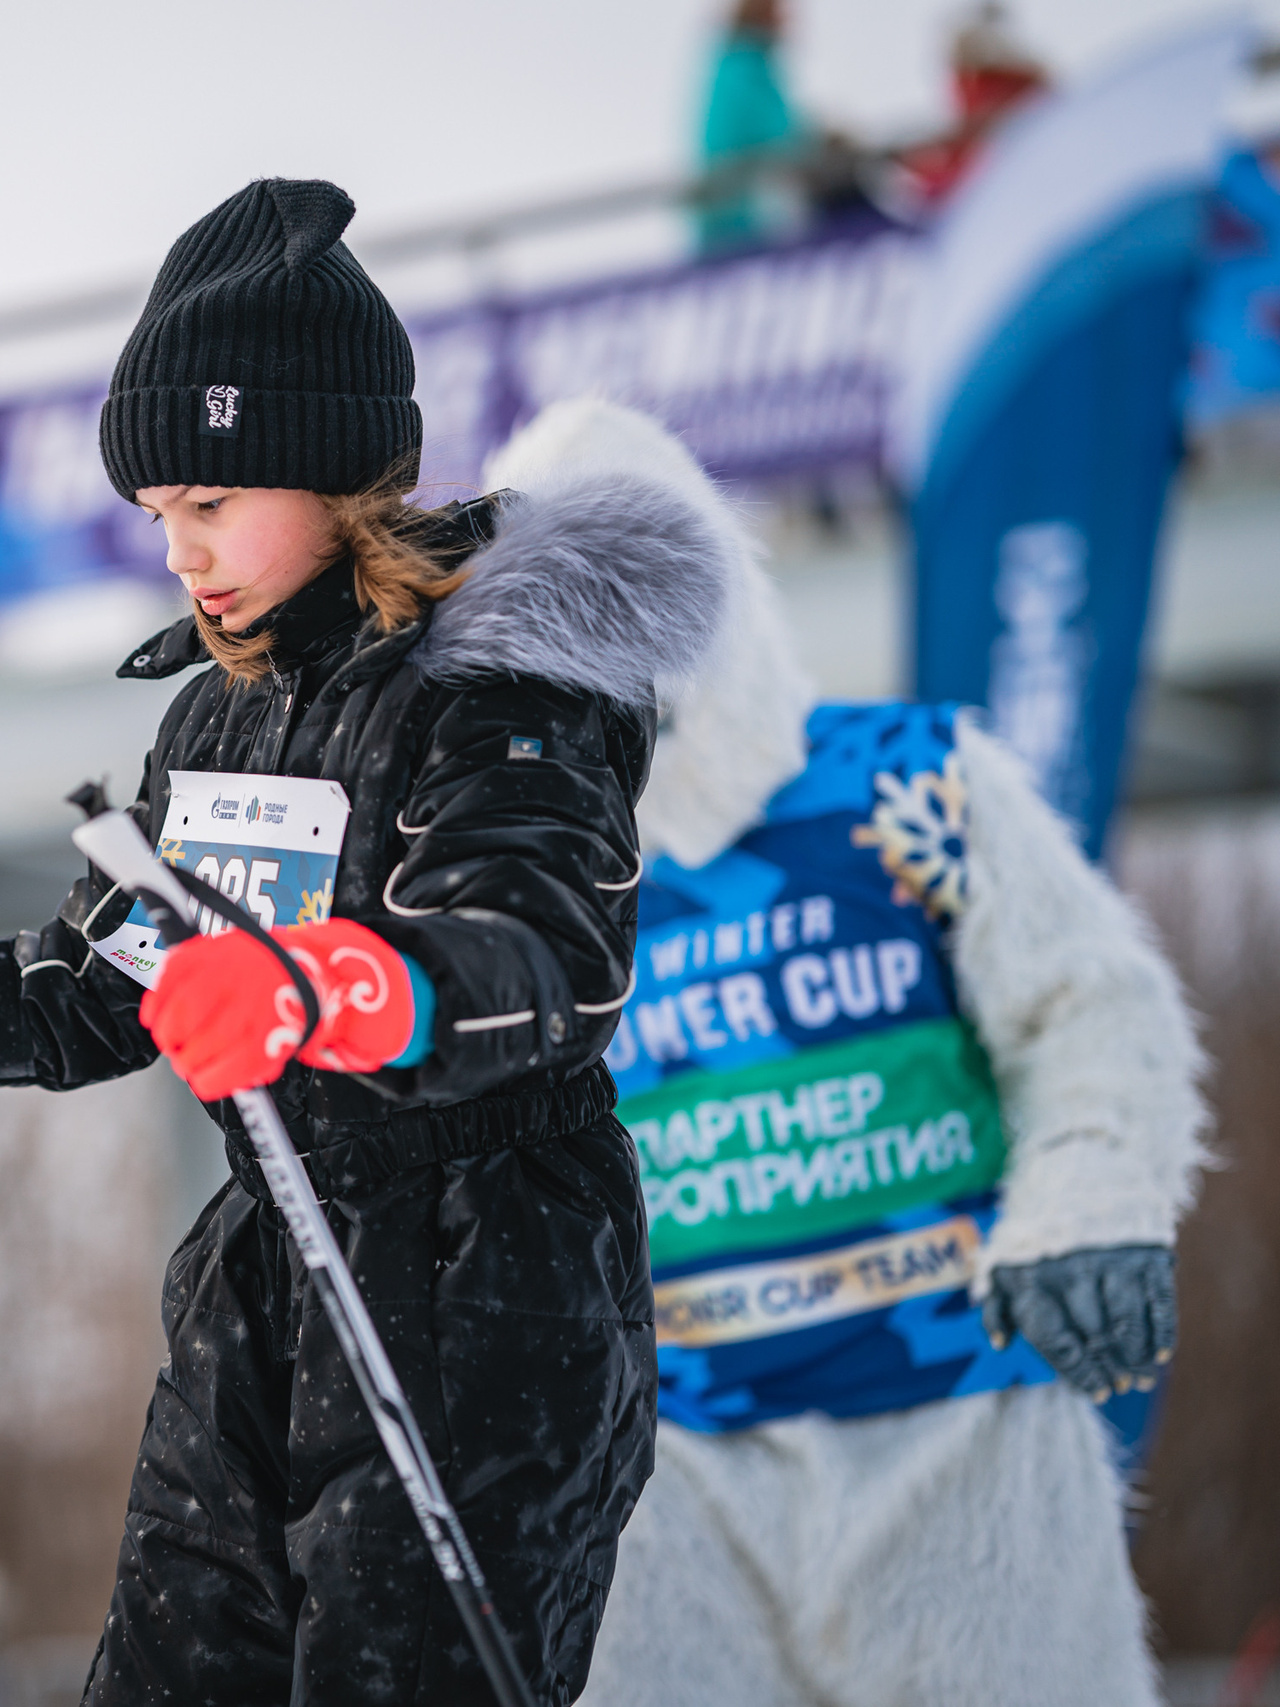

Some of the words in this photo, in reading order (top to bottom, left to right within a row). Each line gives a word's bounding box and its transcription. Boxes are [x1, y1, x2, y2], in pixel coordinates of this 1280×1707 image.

[206, 400, 223, 429] Girl
[220, 385, 240, 429] Lucky
[220, 799, 240, 811] ГАЗПРОМ
[264, 802, 289, 814] РОДНЫЕ
[262, 813, 284, 825] ГОРОДА
[650, 896, 835, 982] WINTER
[110, 951, 137, 967] park
[116, 949, 157, 972] monkey
[780, 938, 920, 1030] CUP
[630, 1072, 885, 1172] ПАРТНЕР
